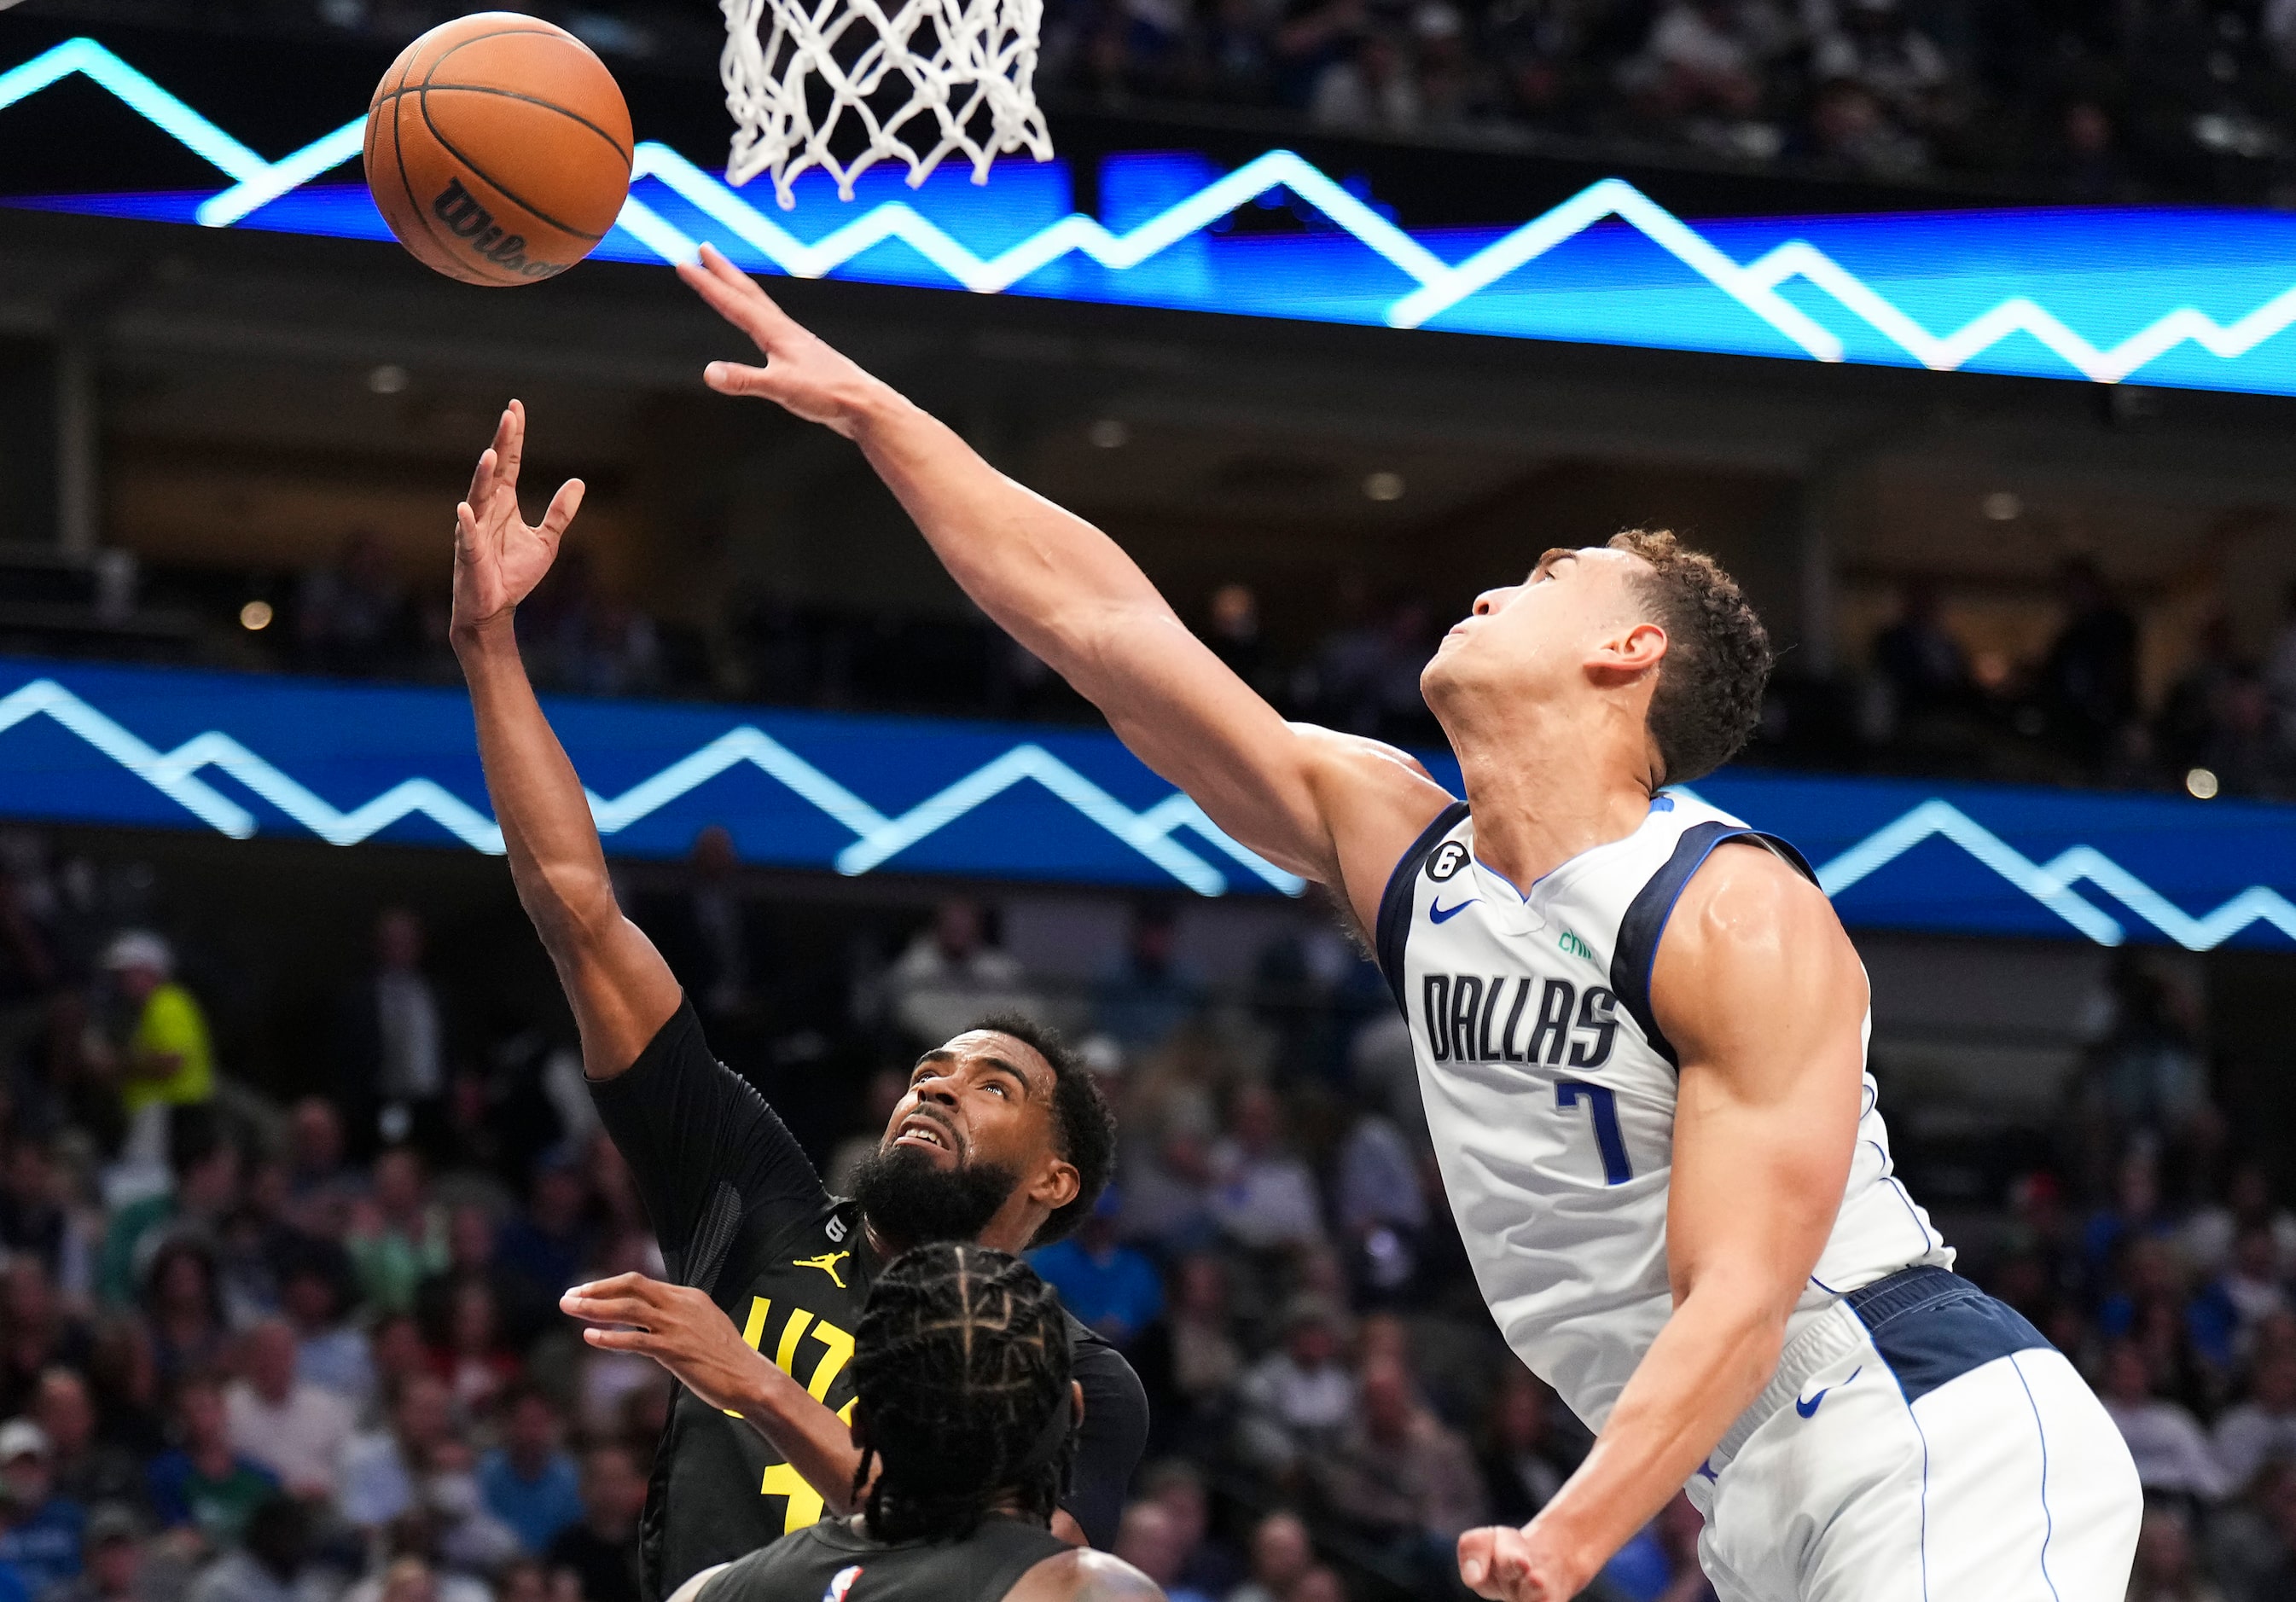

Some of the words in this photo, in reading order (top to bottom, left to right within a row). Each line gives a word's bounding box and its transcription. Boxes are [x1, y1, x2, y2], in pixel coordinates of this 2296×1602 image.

[1433, 845, 1464, 878] 6
[1422, 972, 1621, 1072] DALLAS
[1554, 1078, 1632, 1188] 7
[825, 1214, 848, 1243] 6
